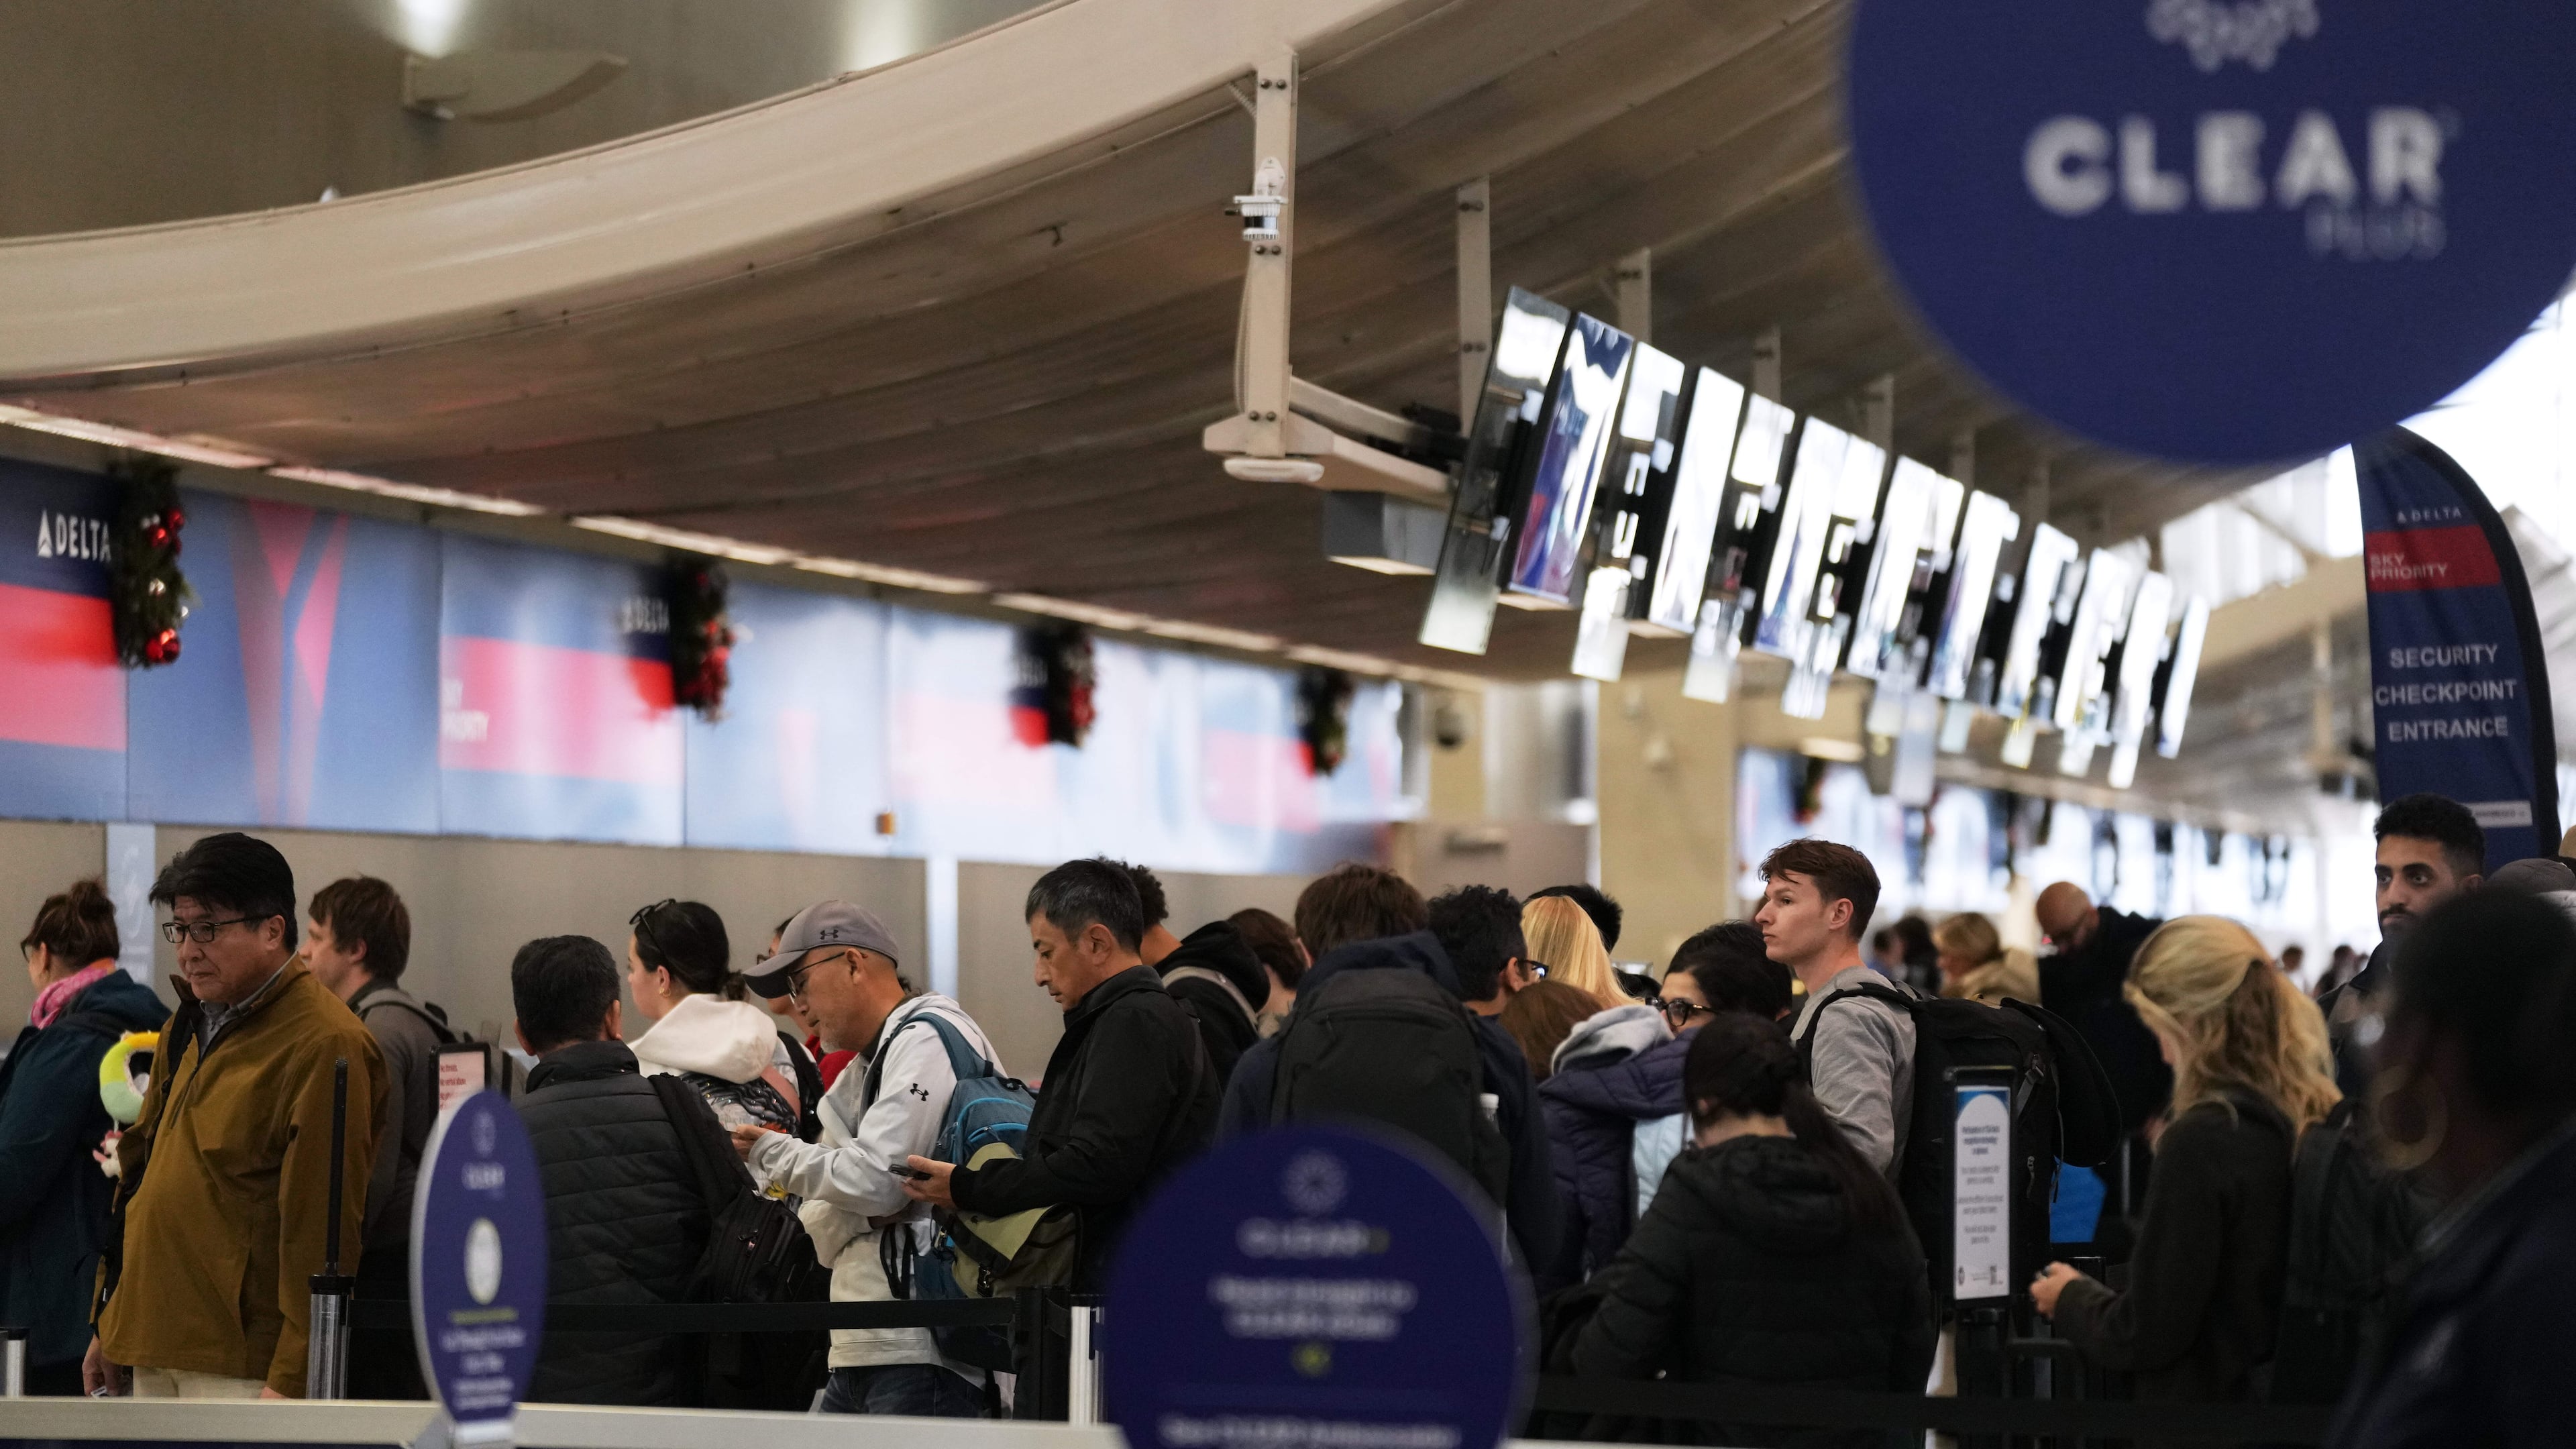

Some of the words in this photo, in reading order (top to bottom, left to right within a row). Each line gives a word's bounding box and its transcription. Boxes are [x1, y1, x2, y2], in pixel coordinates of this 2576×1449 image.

[2023, 105, 2445, 217] CLEAR
[2412, 507, 2462, 522] DELTA
[55, 513, 111, 562] DELTA
[2370, 553, 2405, 568] SKY
[2371, 561, 2449, 581] PRIORITY
[2390, 643, 2498, 669] SECURITY
[2375, 678, 2517, 706] CHECKPOINT
[2389, 715, 2508, 742] ENTRANCE
